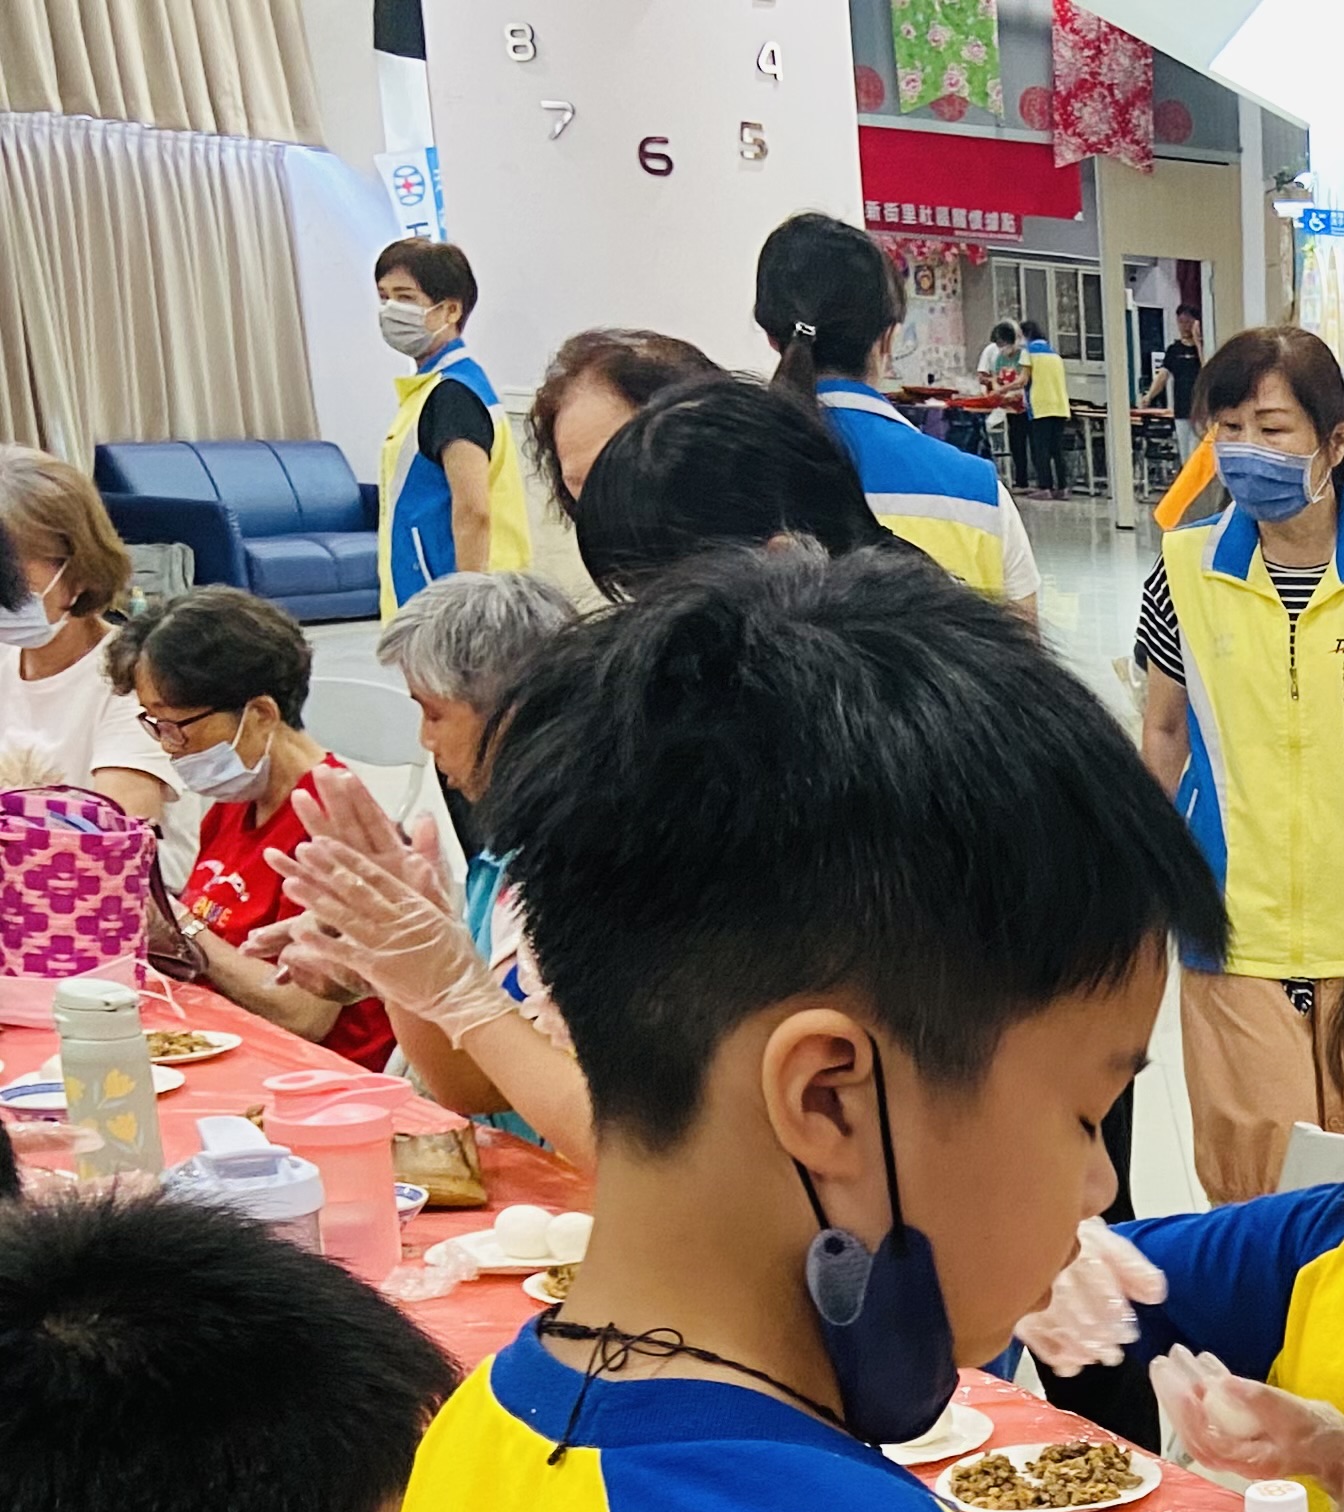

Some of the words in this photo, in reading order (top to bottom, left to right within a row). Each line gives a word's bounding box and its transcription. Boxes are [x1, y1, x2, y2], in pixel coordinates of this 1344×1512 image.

[504, 22, 536, 62] 8
[757, 41, 783, 81] 4
[540, 100, 575, 140] 7
[638, 136, 673, 176] 6
[740, 121, 768, 160] 5
